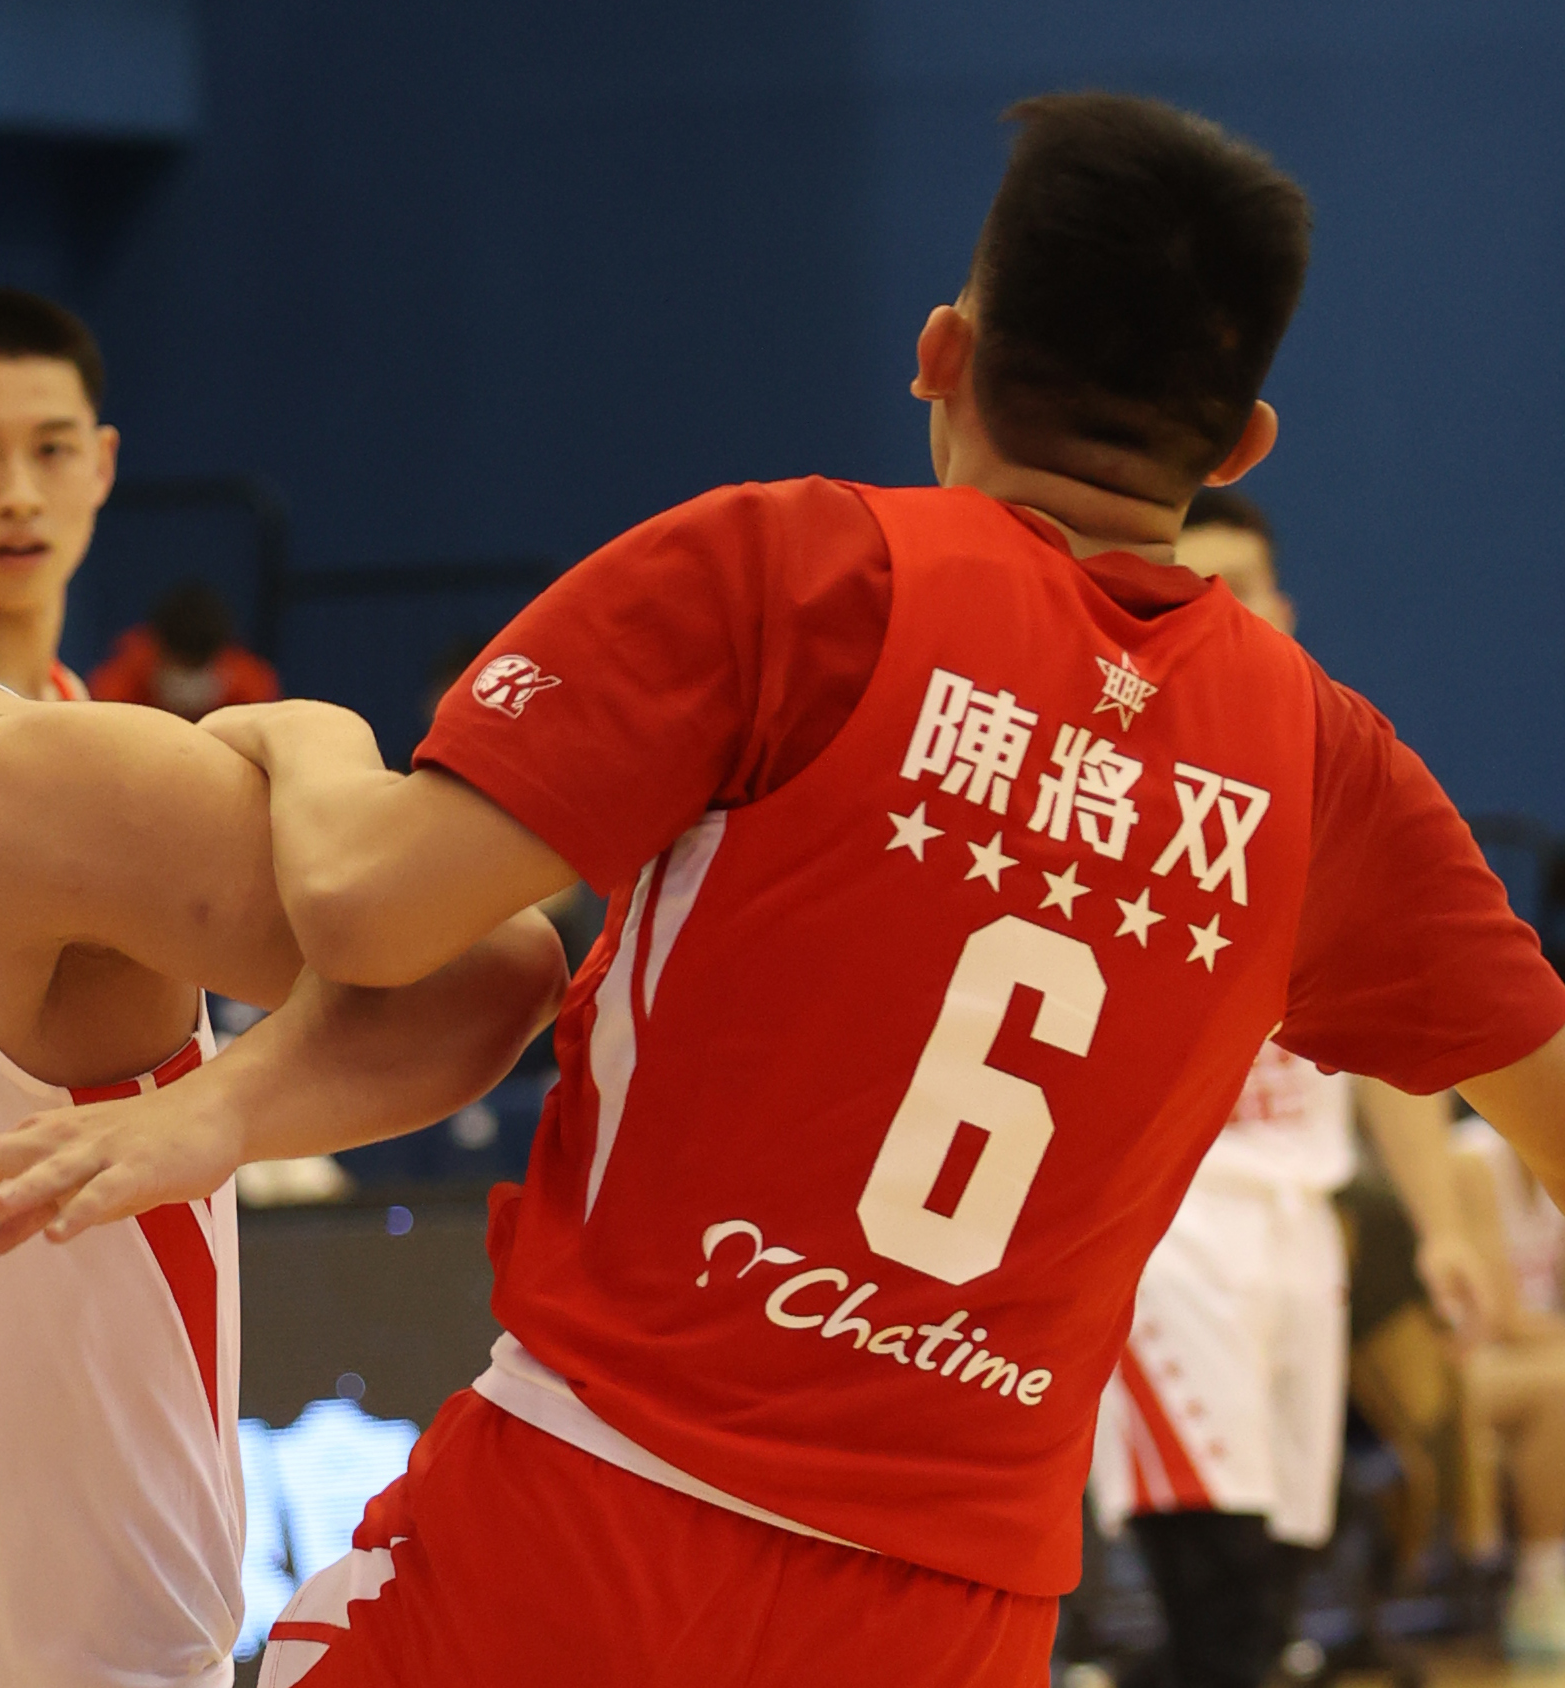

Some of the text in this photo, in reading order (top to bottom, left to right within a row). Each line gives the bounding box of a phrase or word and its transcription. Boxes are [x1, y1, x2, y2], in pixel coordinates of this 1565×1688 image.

[899, 667, 1272, 907] 陳將双
[856, 914, 1108, 1286] 6
[765, 1267, 1054, 1407] Chatime
